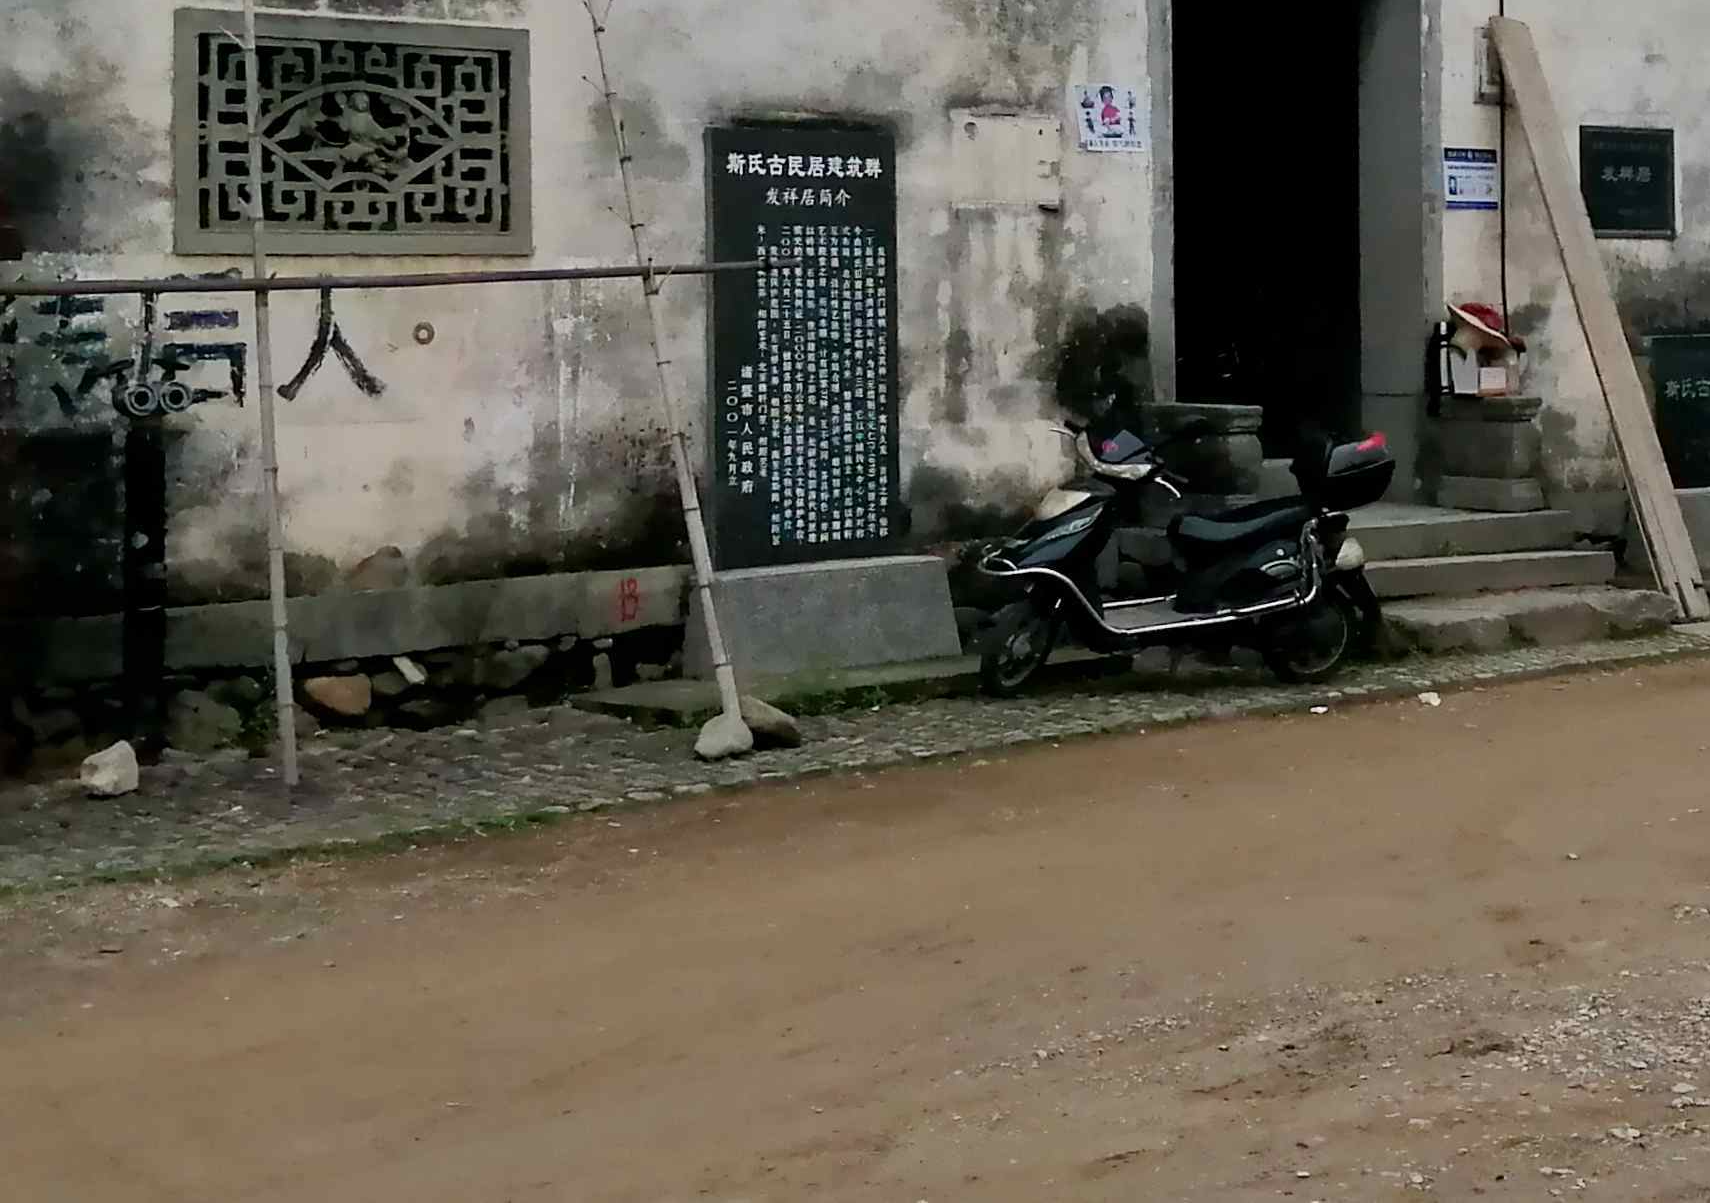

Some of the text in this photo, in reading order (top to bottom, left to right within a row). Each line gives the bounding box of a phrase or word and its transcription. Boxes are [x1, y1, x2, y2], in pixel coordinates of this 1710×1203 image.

[726, 151, 883, 179] 斯氏古民居建筑群
[765, 187, 852, 208] 发祥居简介
